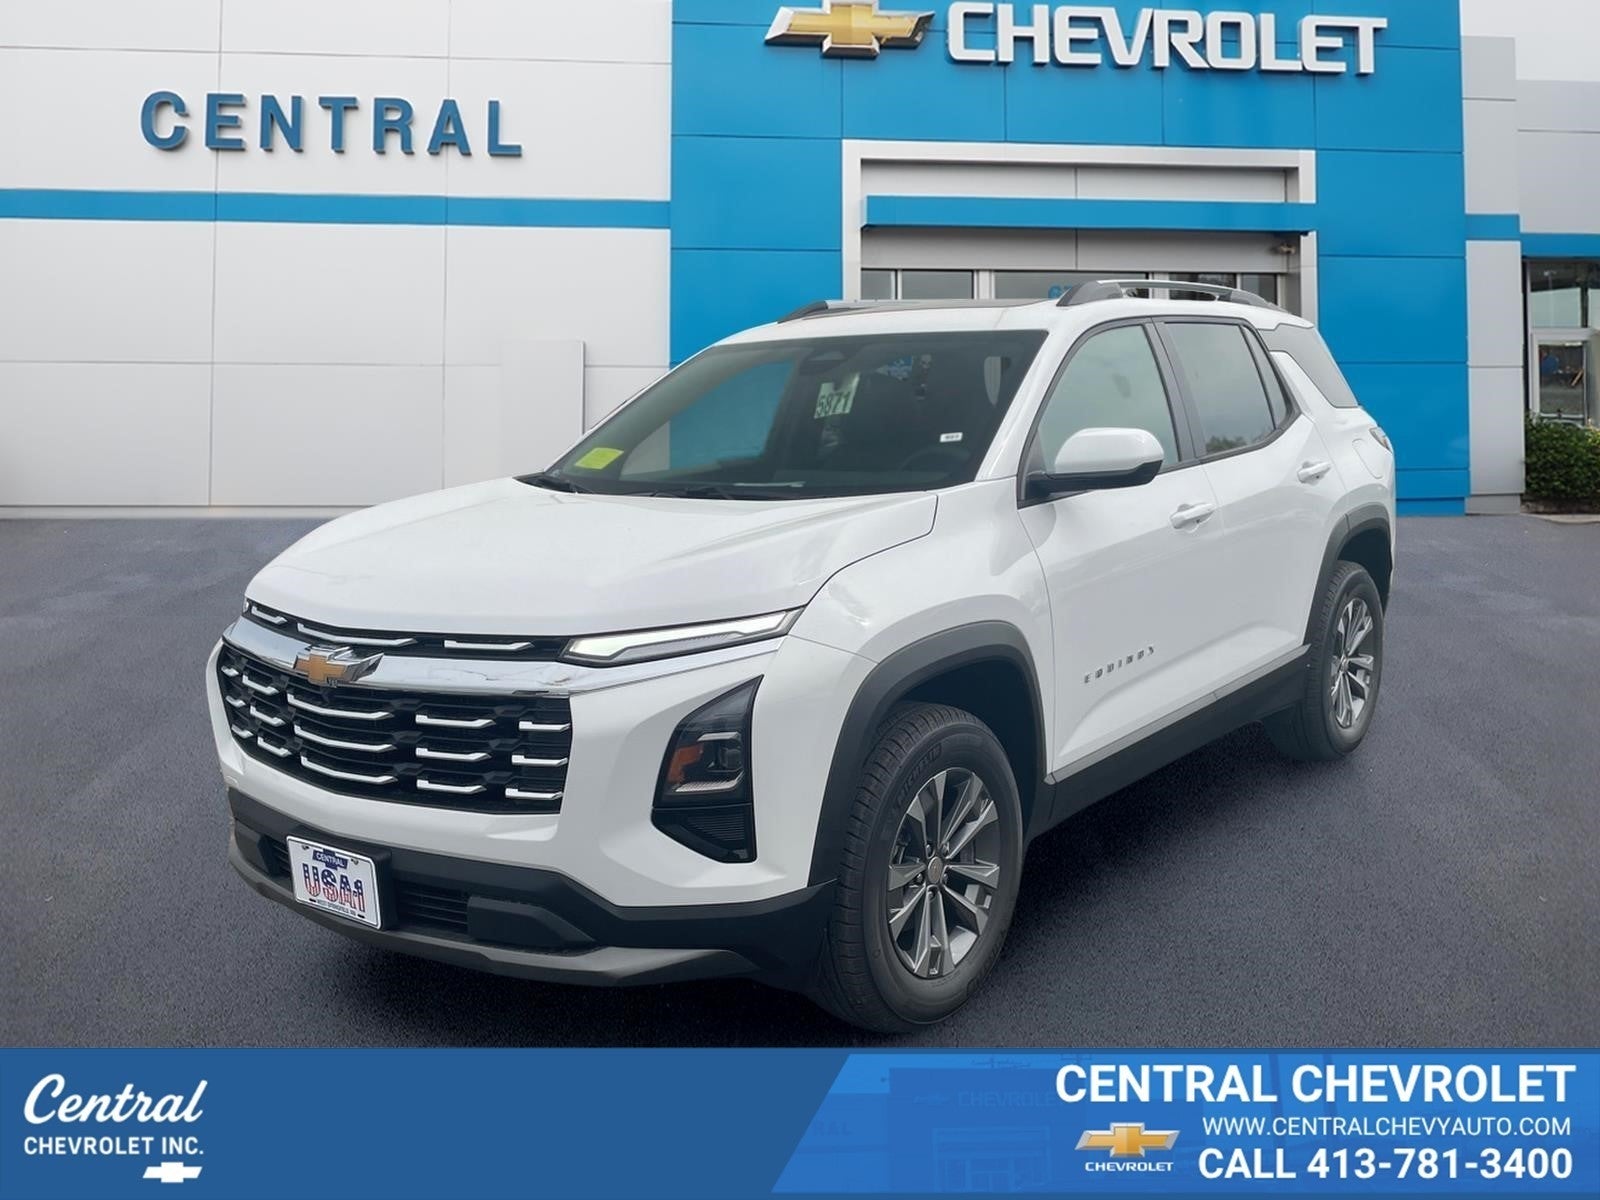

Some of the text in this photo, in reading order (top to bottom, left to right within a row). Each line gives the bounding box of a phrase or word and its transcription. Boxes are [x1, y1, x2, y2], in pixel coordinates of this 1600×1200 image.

[947, 1, 1388, 75] CHEVROLET
[141, 91, 522, 156] CENTRAL
[316, 853, 345, 867] CENTRAL
